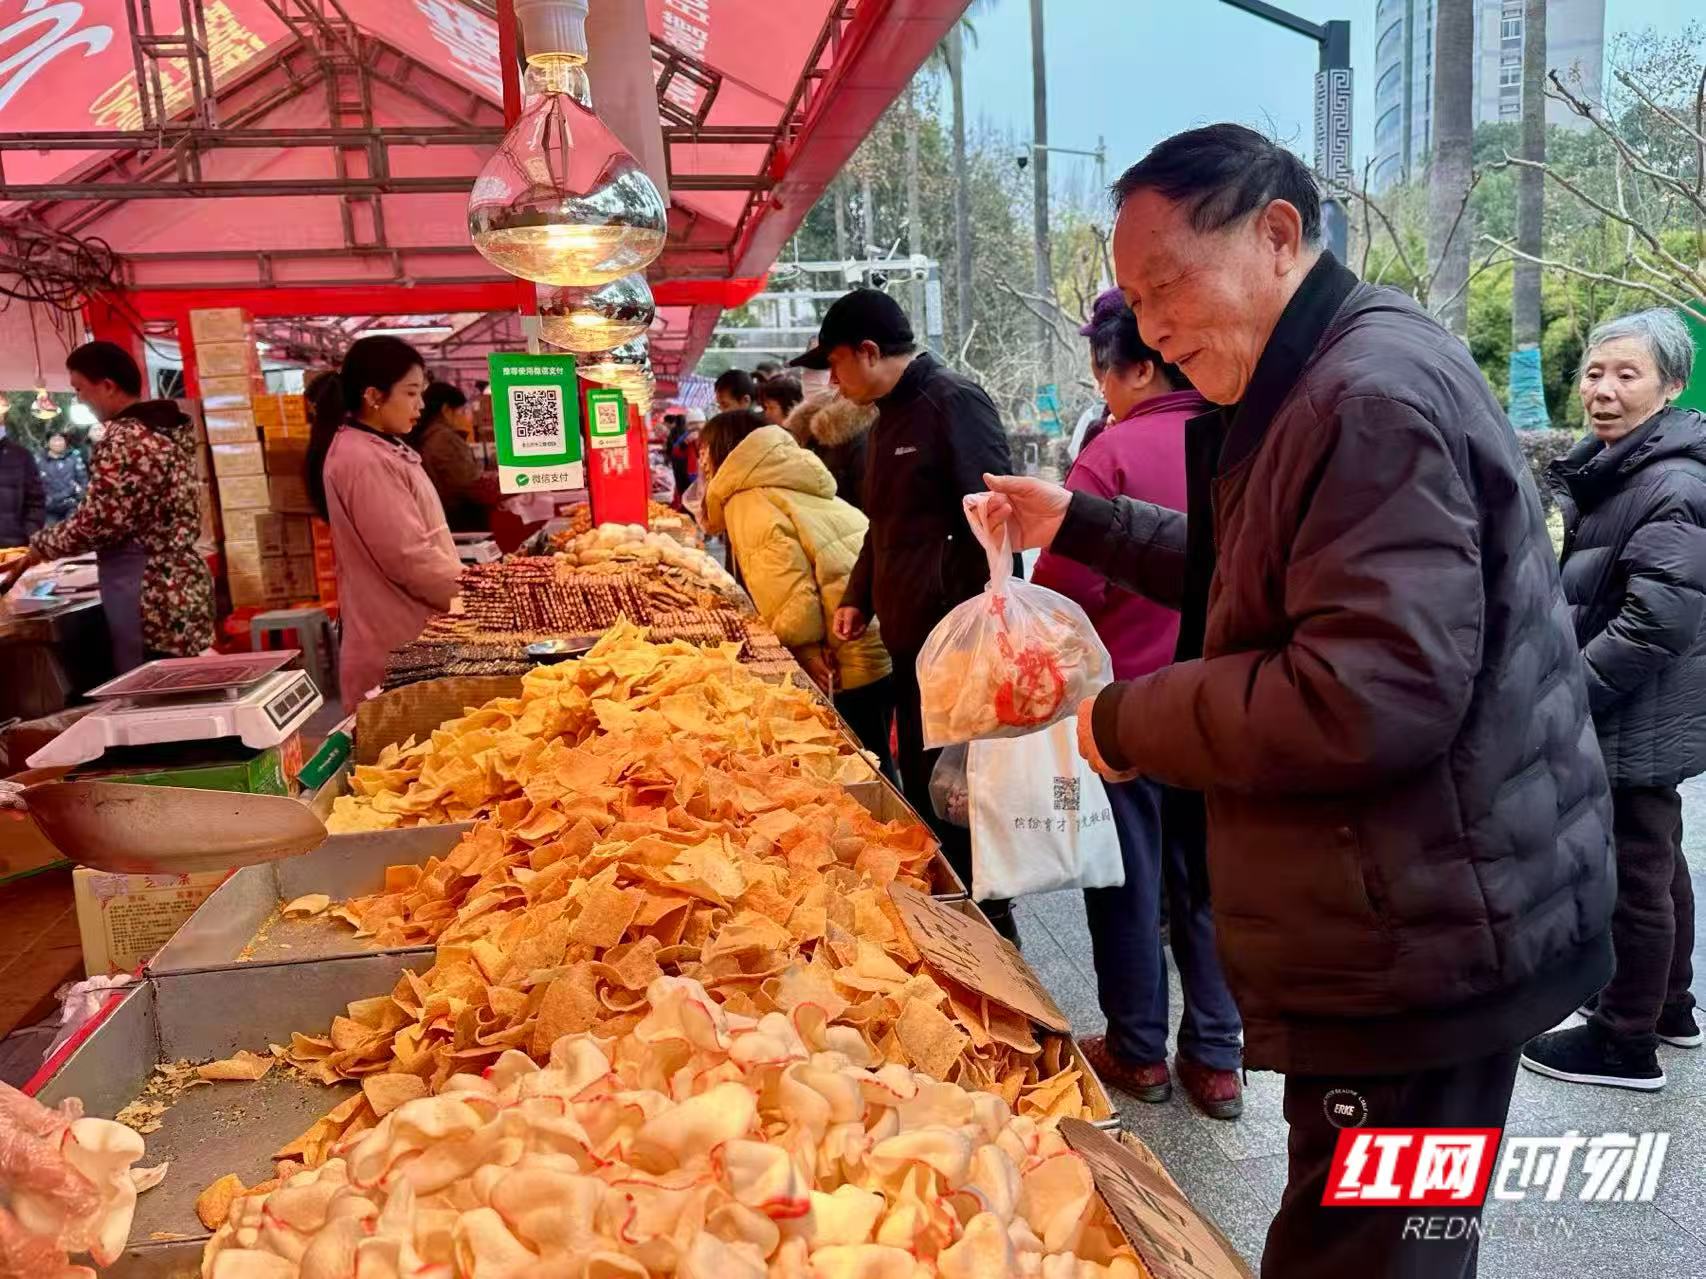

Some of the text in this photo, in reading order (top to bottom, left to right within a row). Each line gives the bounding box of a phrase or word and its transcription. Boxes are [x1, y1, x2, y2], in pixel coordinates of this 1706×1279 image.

[531, 472, 569, 484] 微信支付
[1333, 1103, 1355, 1116] ERKE
